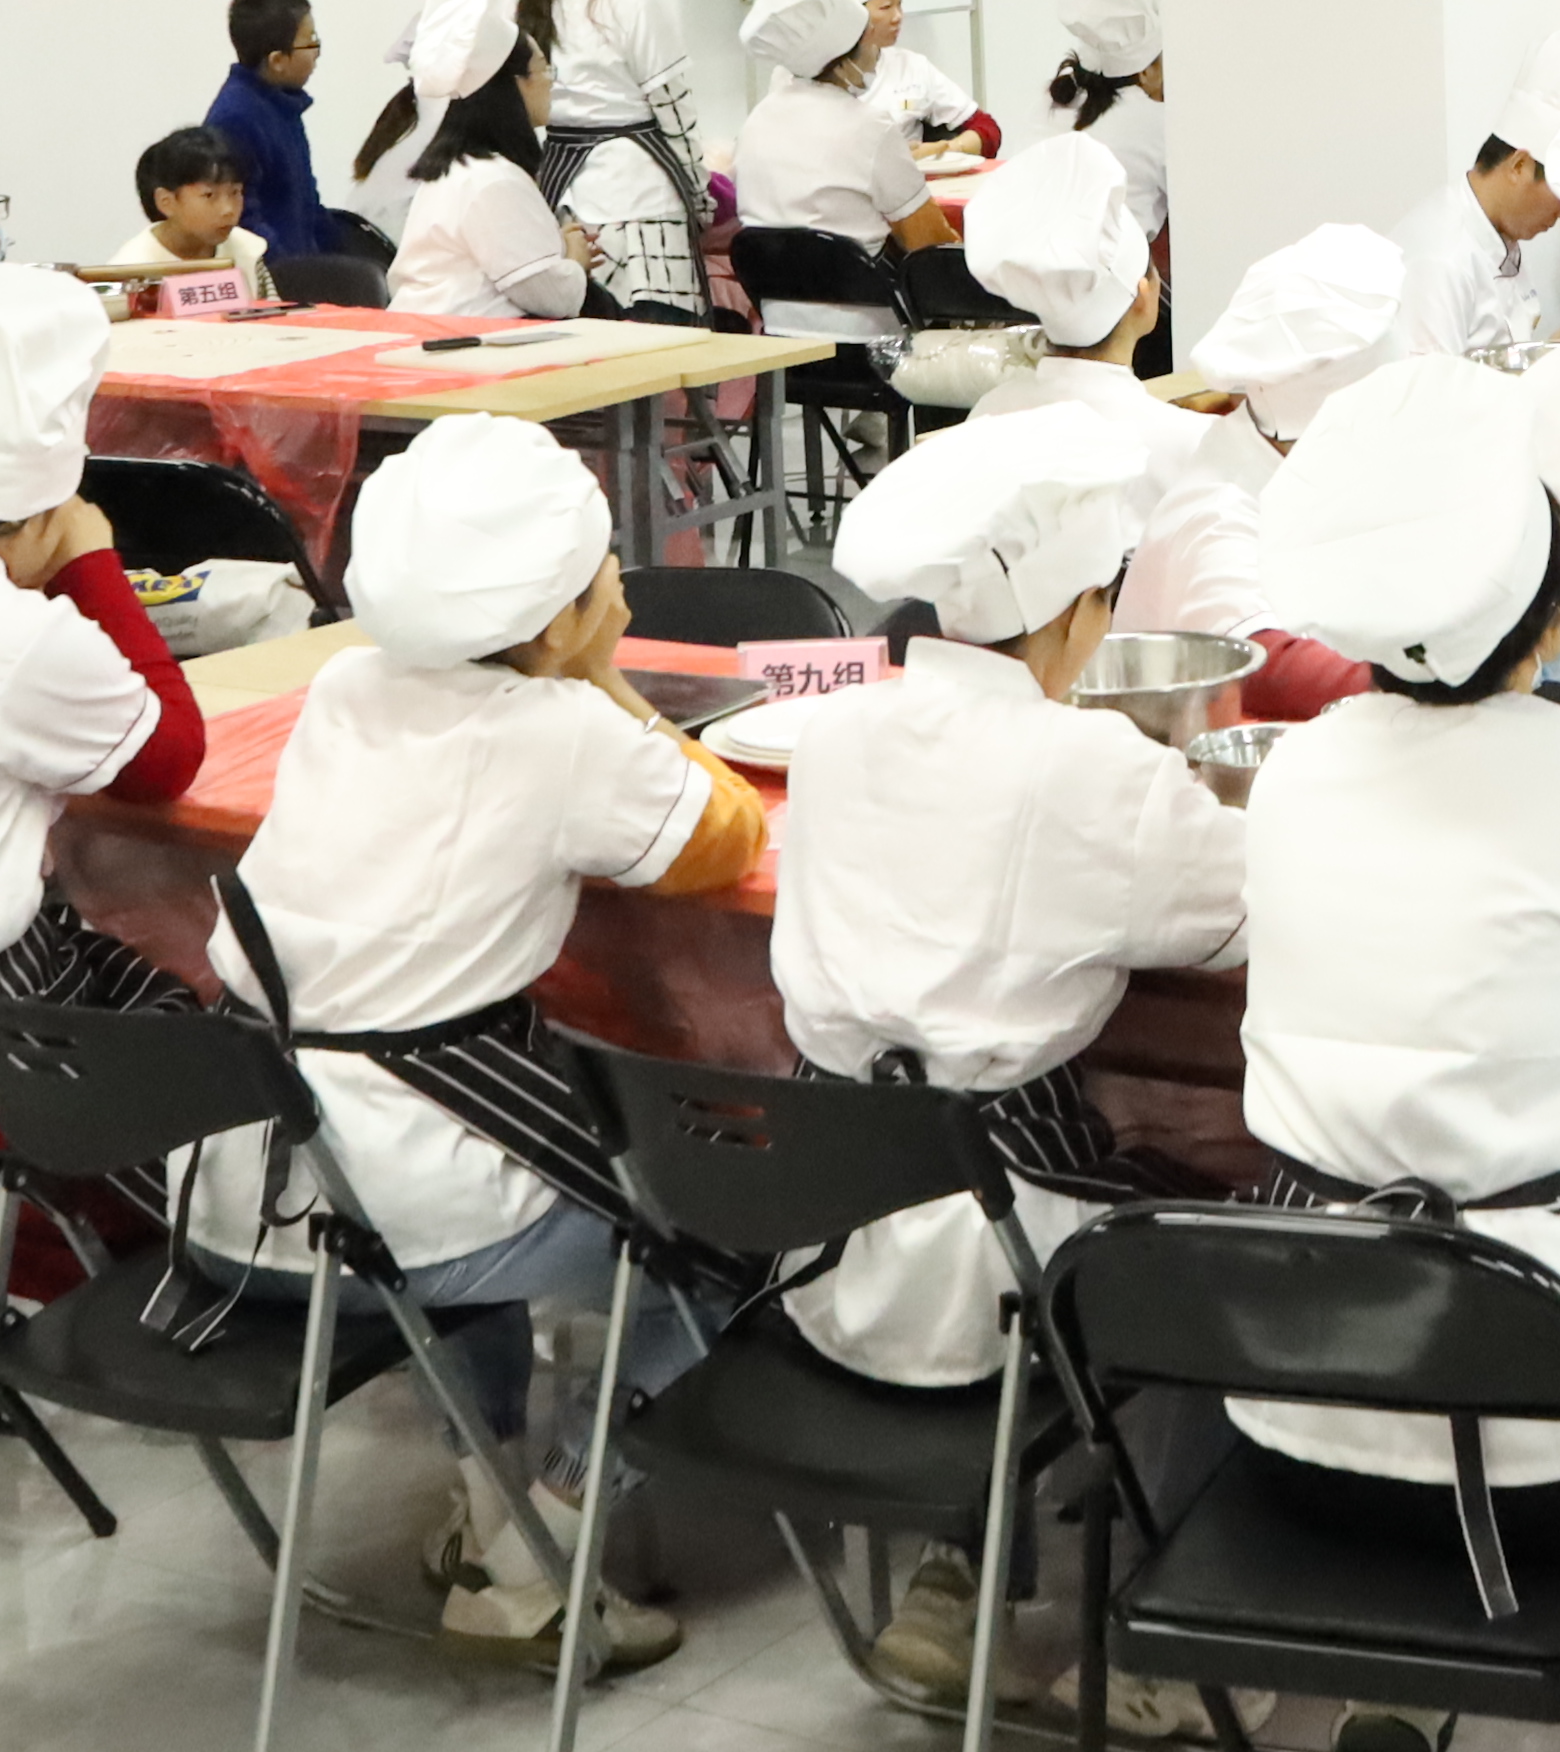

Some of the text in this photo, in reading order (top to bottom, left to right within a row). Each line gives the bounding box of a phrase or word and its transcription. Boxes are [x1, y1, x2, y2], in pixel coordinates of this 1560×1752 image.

[178, 281, 239, 306] 第五组
[762, 661, 864, 696] 第九组
